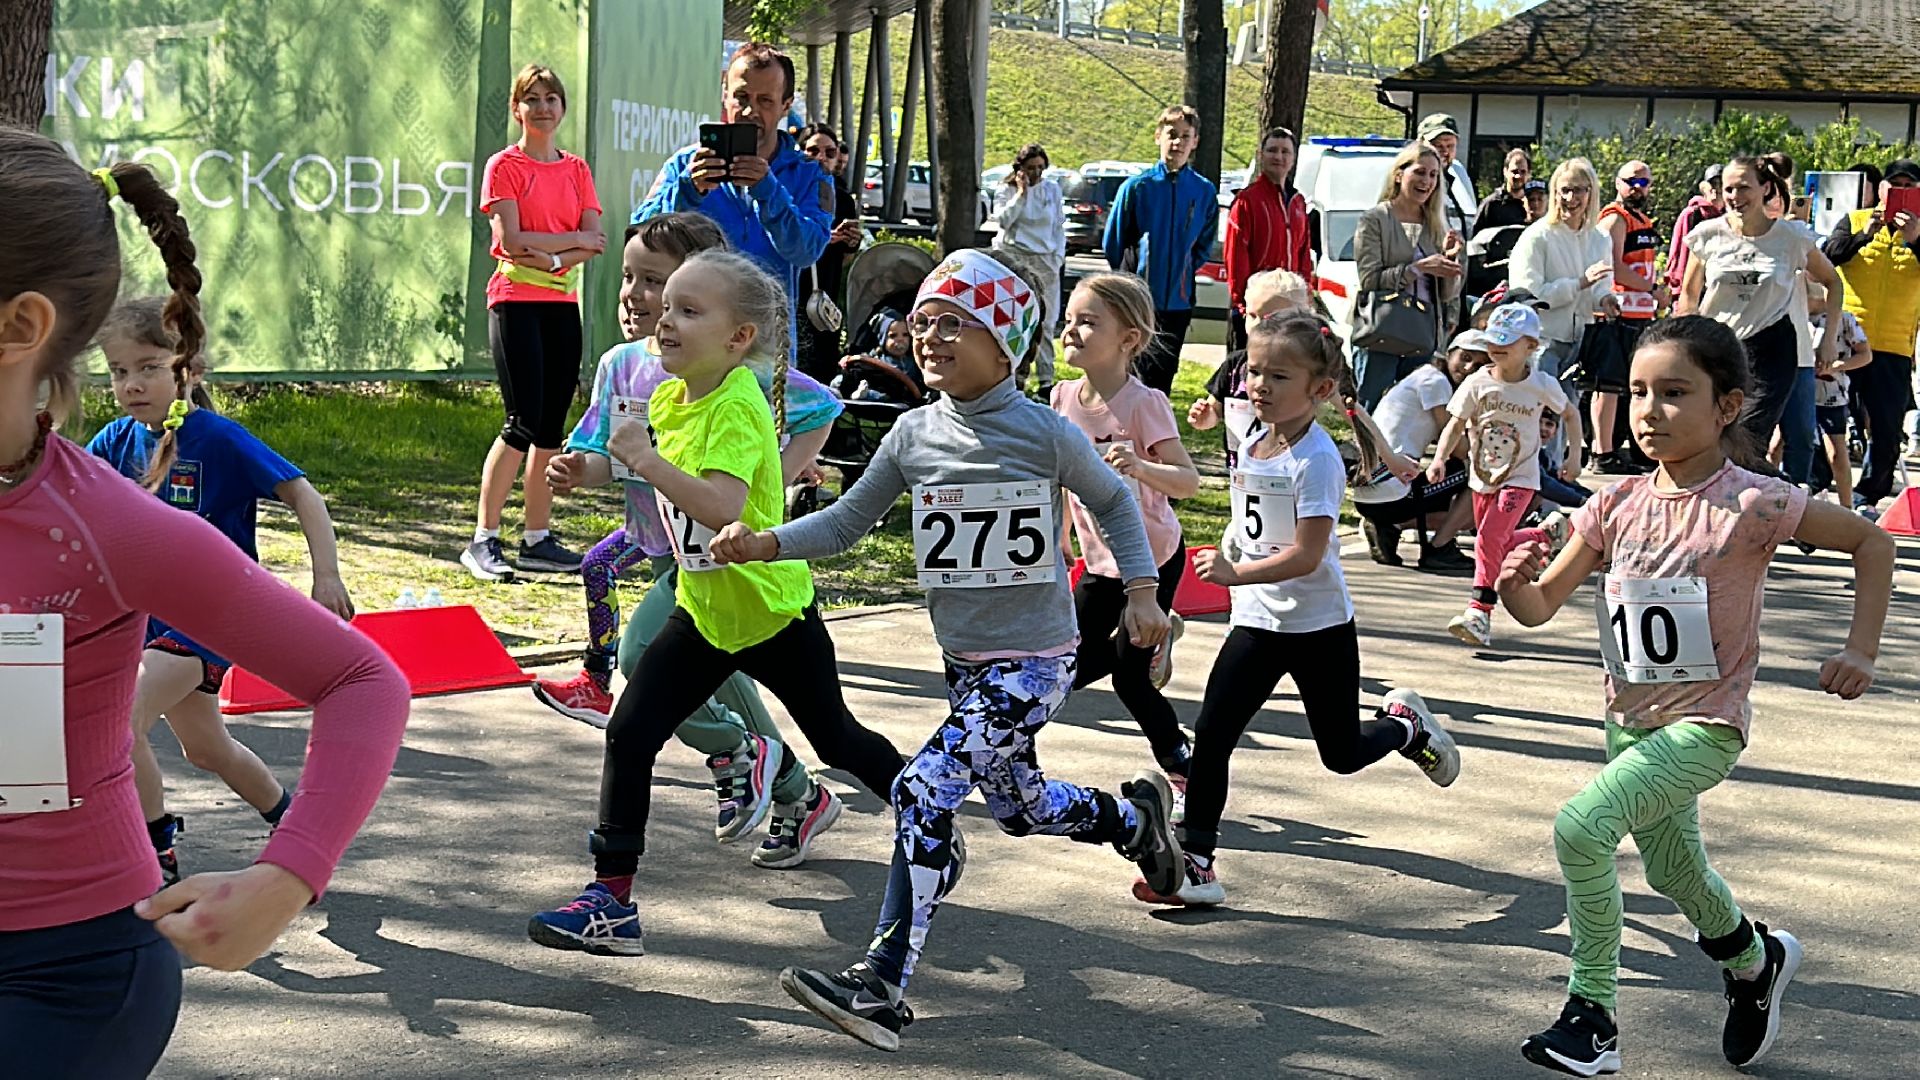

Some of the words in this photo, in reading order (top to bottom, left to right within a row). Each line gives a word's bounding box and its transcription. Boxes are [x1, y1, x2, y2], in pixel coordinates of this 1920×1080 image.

[611, 98, 710, 155] ТЕРРИТОРИ
[920, 507, 1046, 569] 275
[1245, 494, 1263, 540] 5
[1611, 604, 1679, 665] 10
